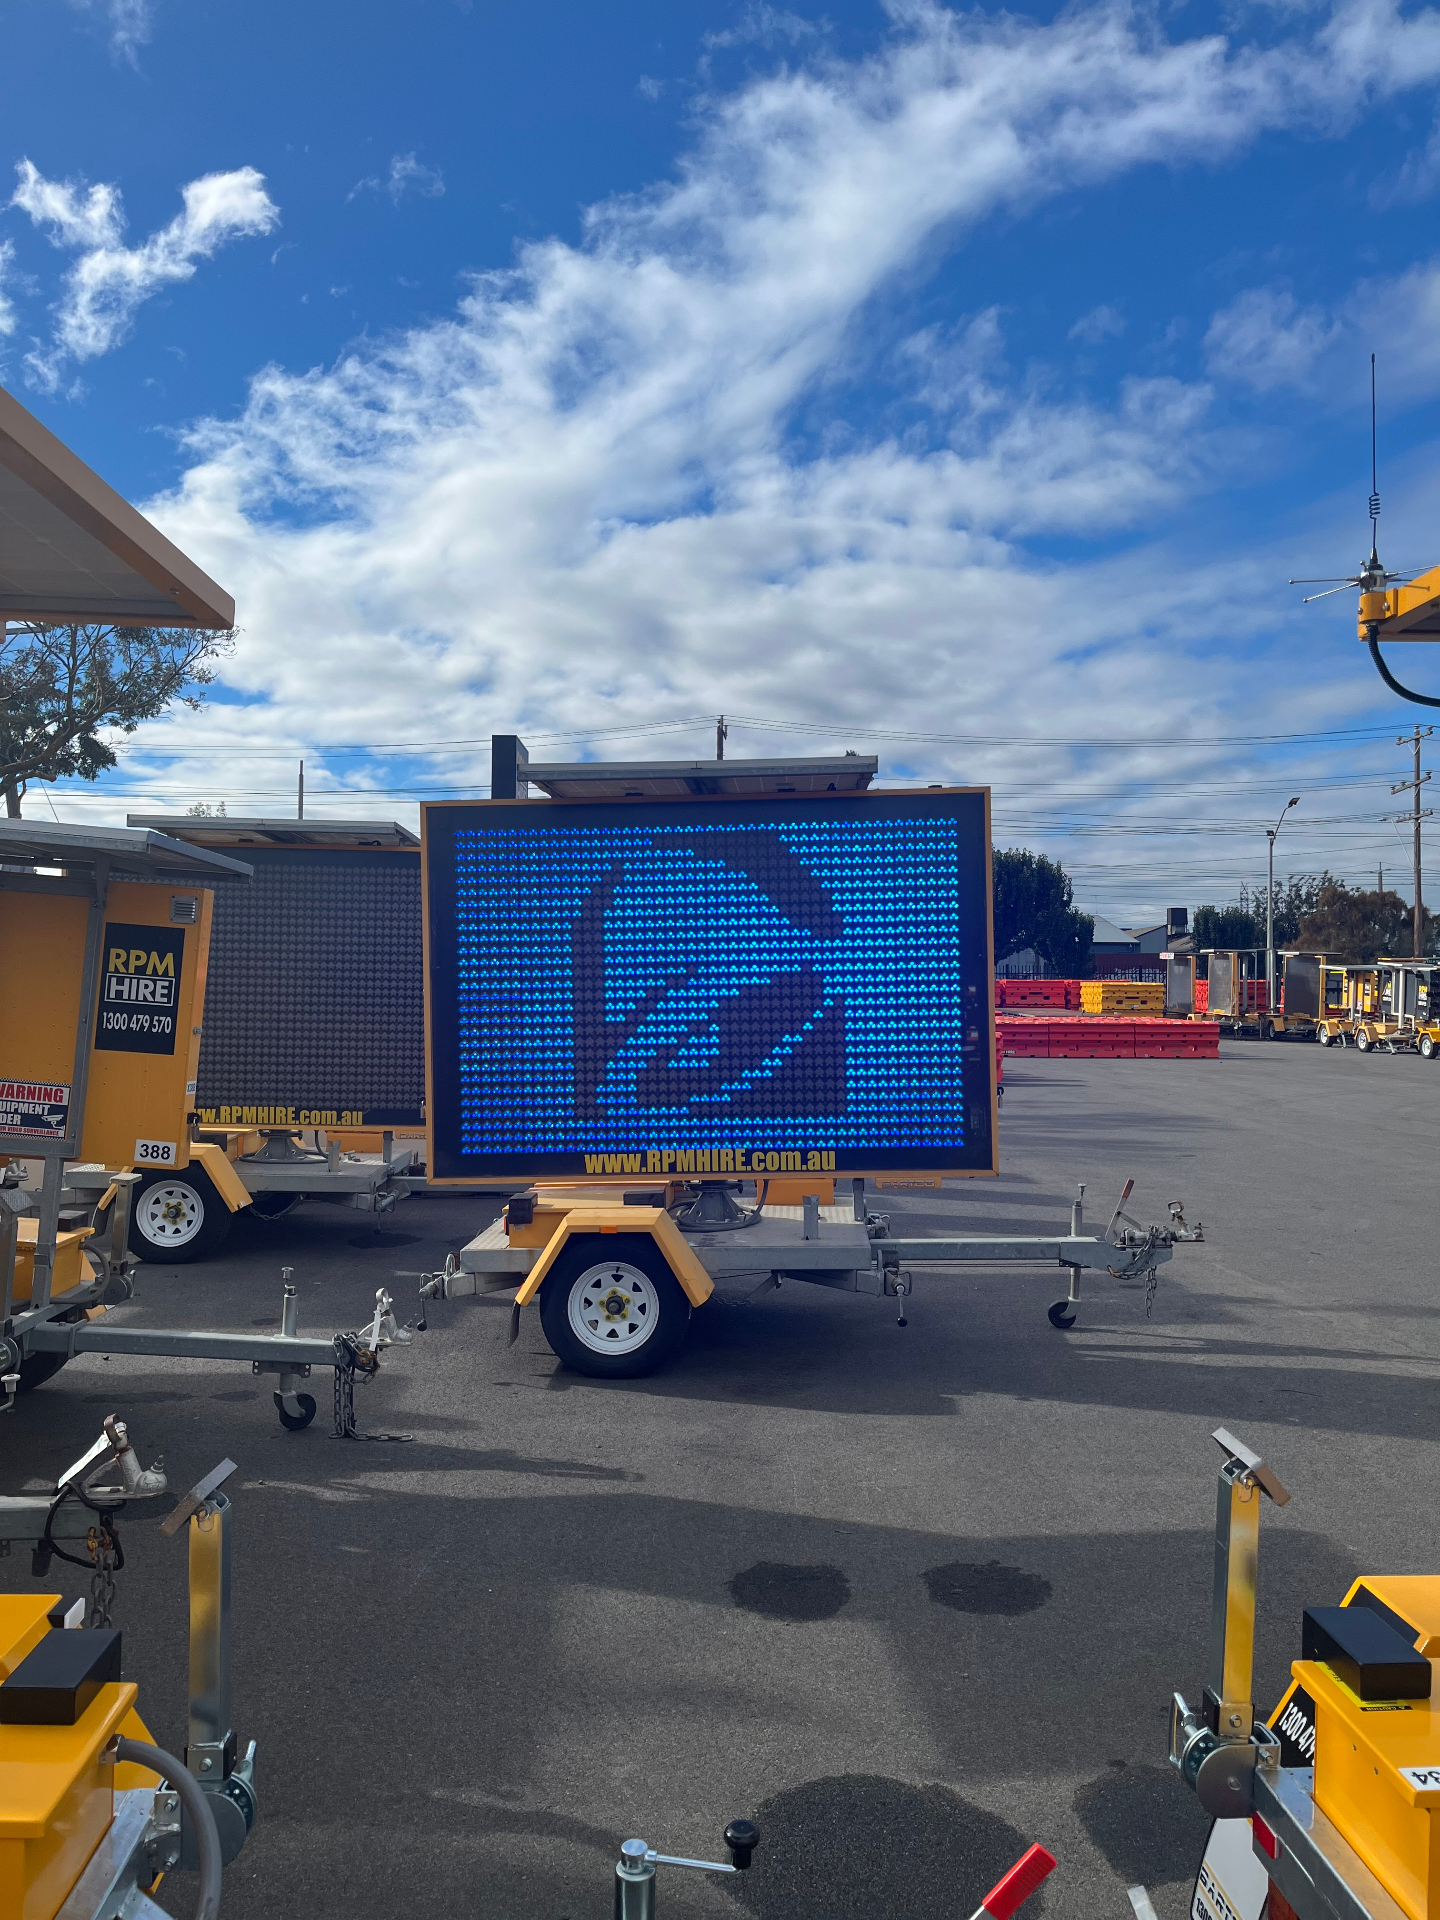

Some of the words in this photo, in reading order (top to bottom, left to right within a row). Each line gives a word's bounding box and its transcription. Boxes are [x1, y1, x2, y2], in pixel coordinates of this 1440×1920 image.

[108, 947, 175, 977] RPM
[109, 977, 169, 1003] HIRE
[102, 1011, 128, 1030] 1300
[129, 1014, 150, 1032] 479
[151, 1015, 172, 1034] 570
[194, 1105, 363, 1126] w.RPMHIRE.com.au
[23, 1128, 60, 1137] SURVEILLANCE
[139, 1143, 171, 1160] 388
[584, 1148, 836, 1174] www.RPMHIRE.com.au
[1279, 1702, 1307, 1742] 1300
